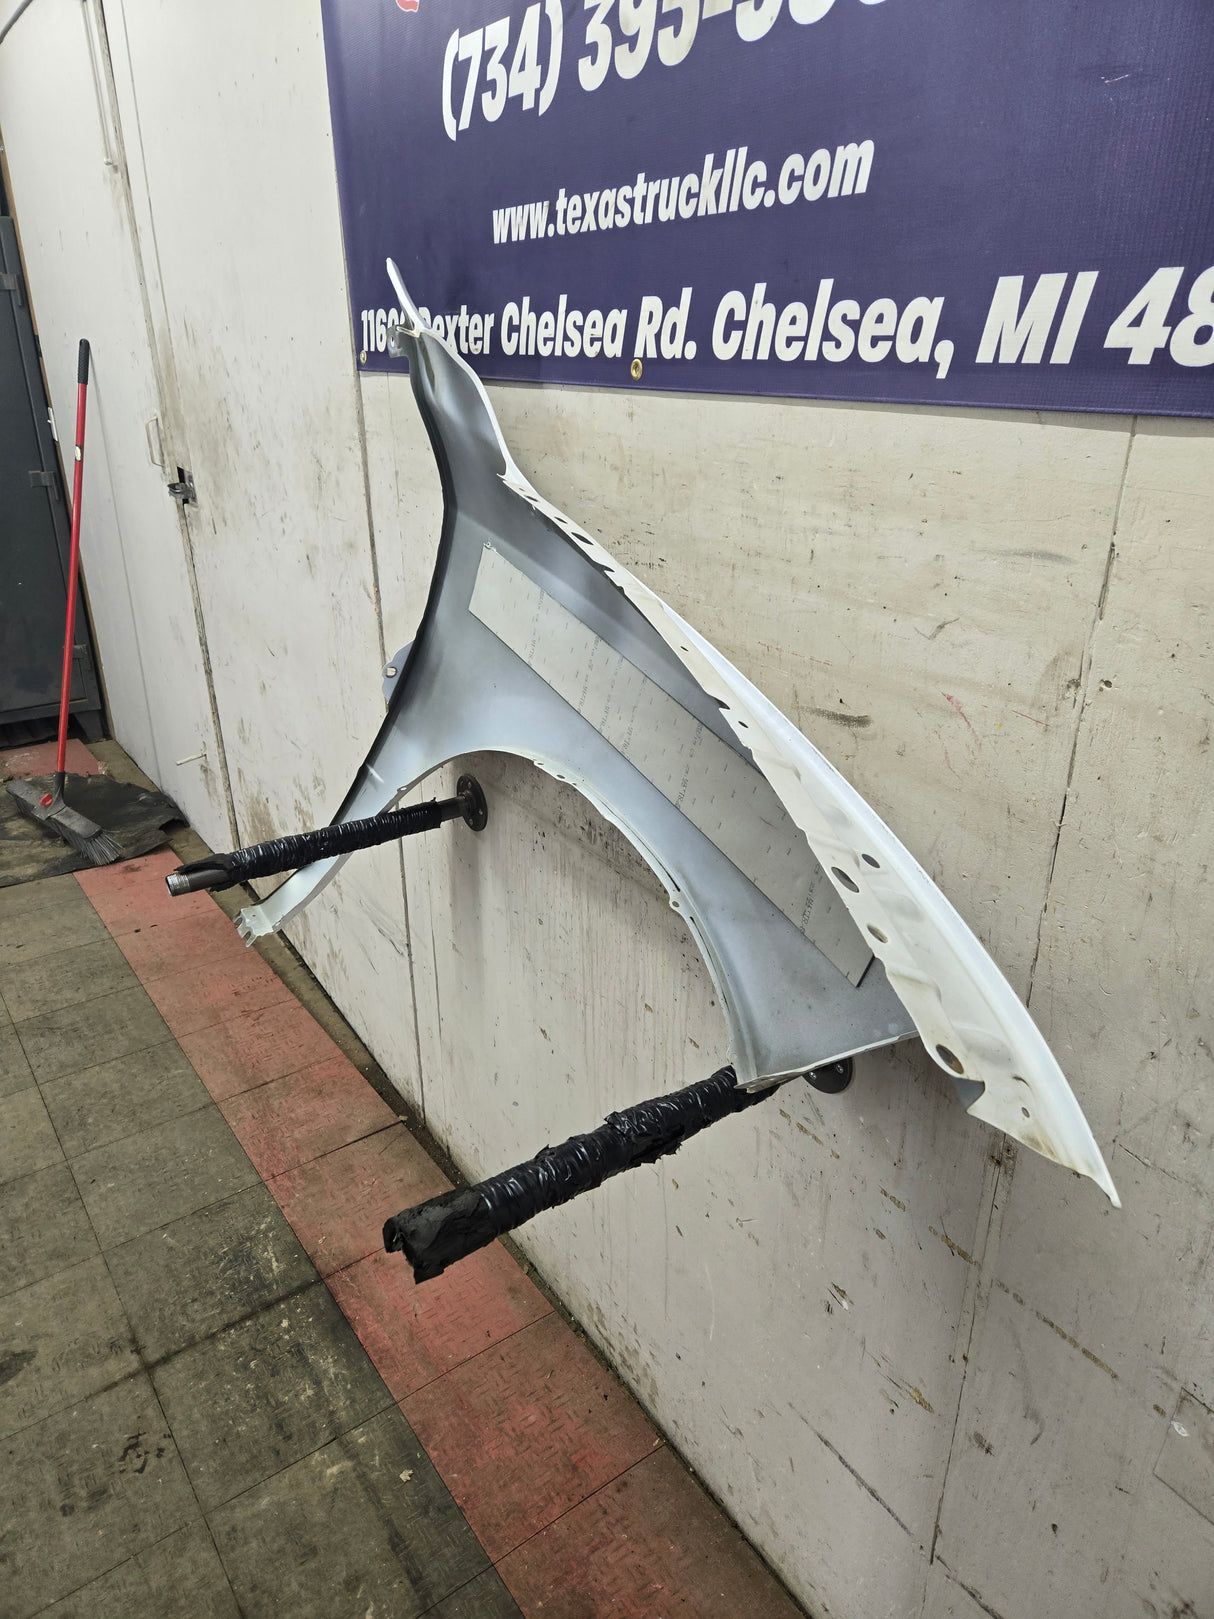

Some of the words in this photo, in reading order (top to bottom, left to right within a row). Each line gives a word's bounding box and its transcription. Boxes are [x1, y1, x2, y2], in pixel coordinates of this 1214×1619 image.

[442, 0, 563, 141] (734)
[492, 139, 875, 244] www.texastruckllc.com
[500, 294, 627, 358] Chelsea
[634, 287, 697, 359] Rd.
[712, 278, 955, 379] Chelsea,
[975, 270, 1099, 364] MI
[1103, 266, 1214, 367] 48
